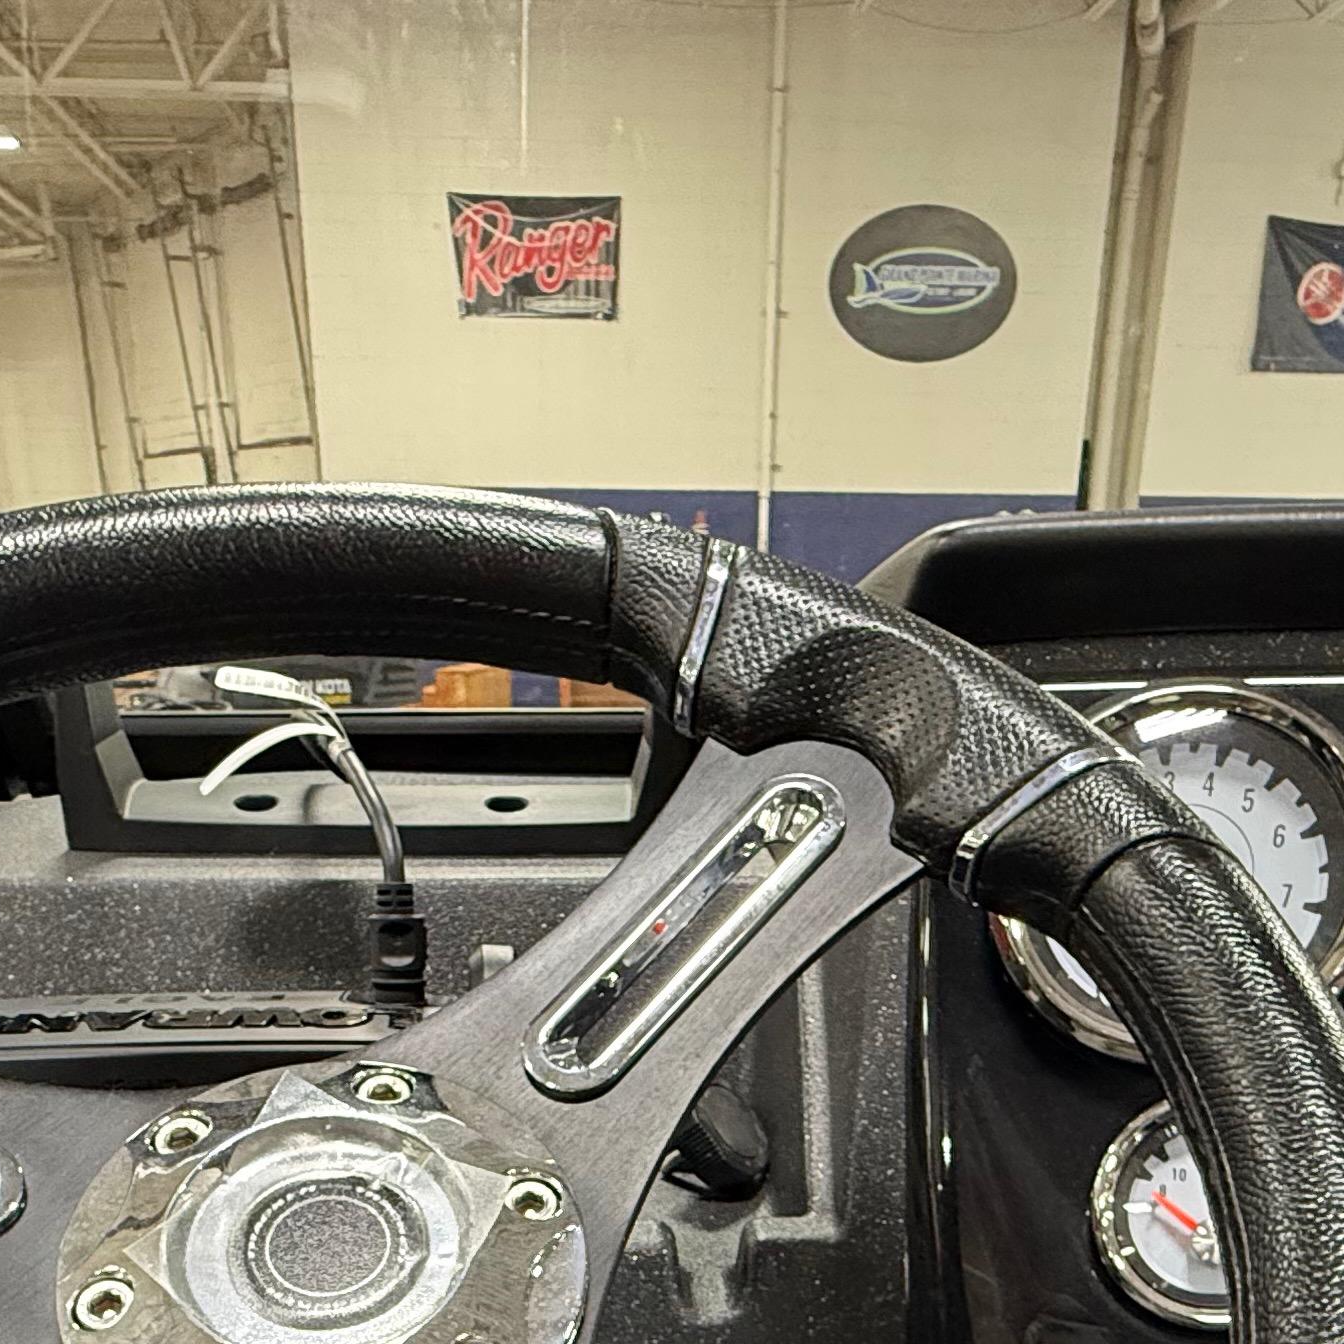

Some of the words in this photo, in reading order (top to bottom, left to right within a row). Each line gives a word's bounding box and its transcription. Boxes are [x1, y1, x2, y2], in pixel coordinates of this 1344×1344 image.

[453, 200, 616, 302] Ranger
[1202, 772, 1215, 797] 4
[1241, 788, 1255, 812] 5
[1273, 824, 1286, 848] 6
[1282, 883, 1293, 908] 7
[1172, 1168, 1187, 1182] 10
